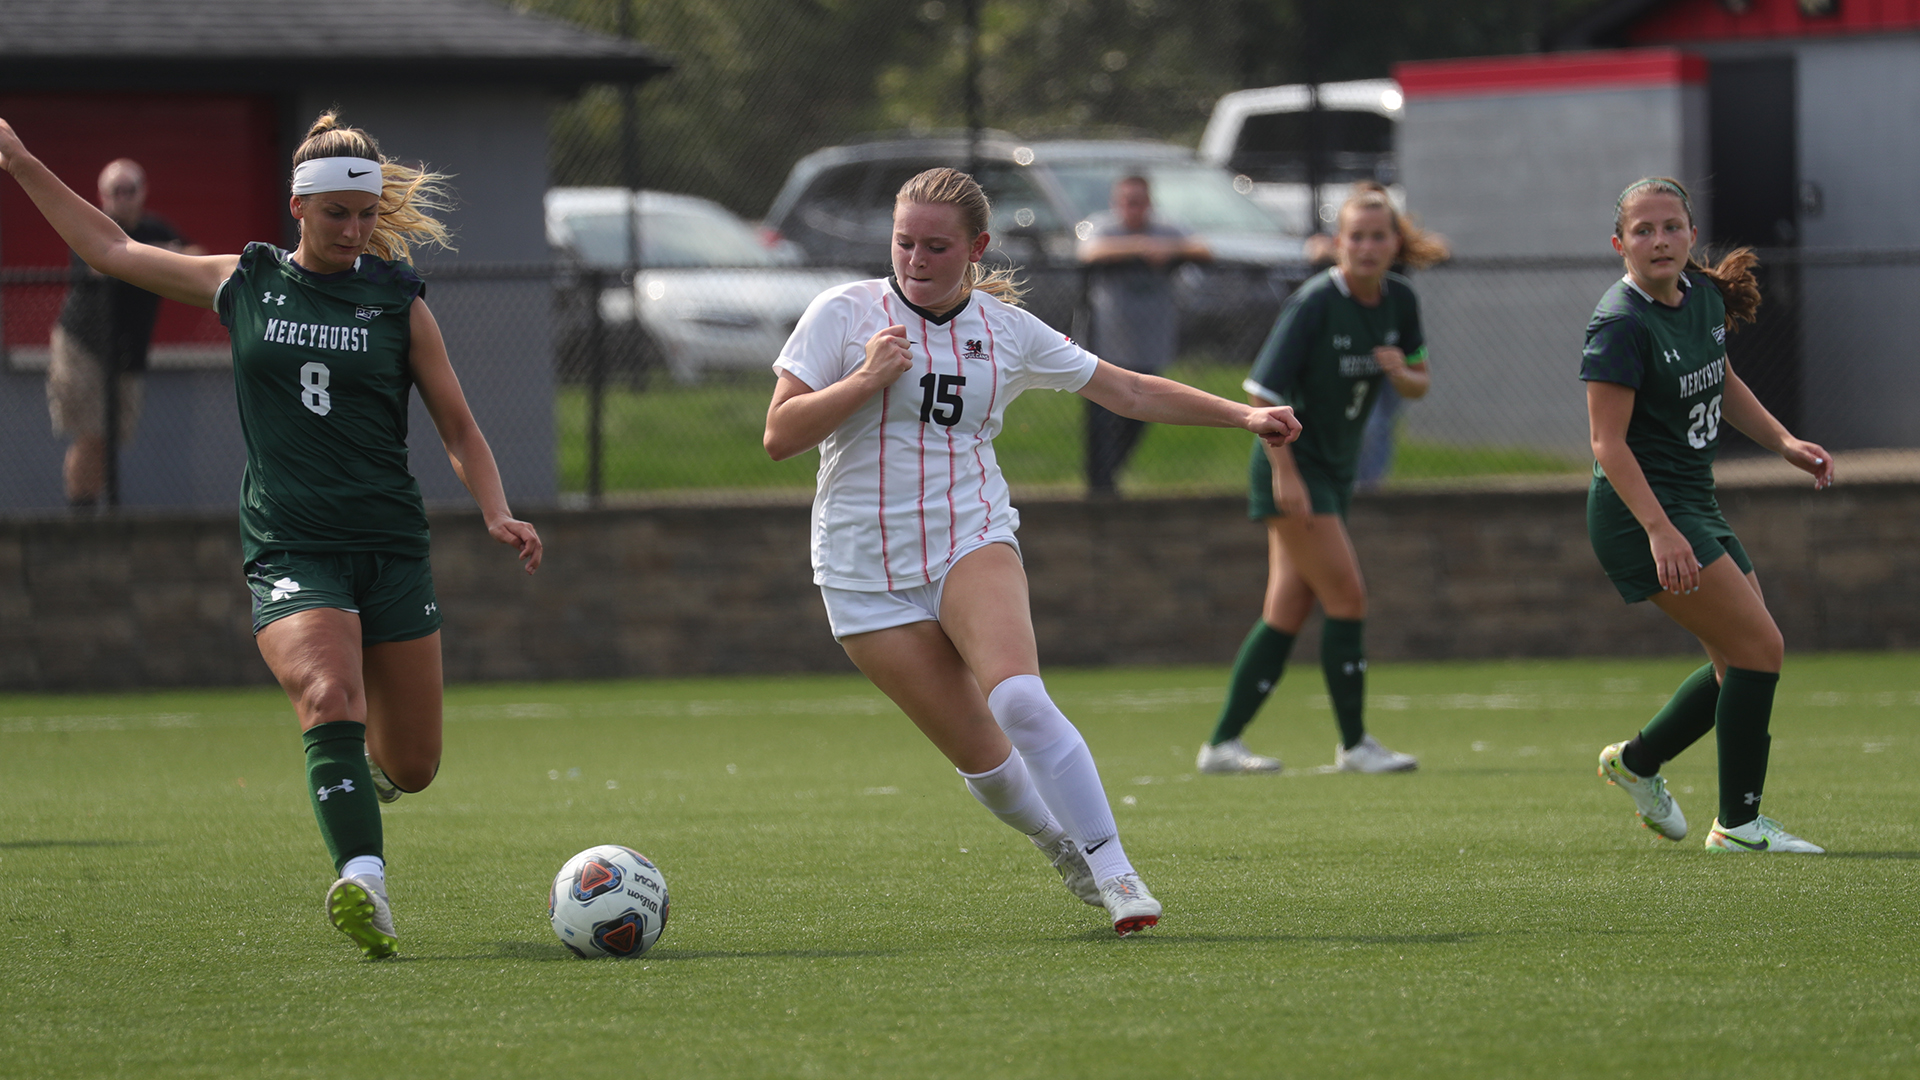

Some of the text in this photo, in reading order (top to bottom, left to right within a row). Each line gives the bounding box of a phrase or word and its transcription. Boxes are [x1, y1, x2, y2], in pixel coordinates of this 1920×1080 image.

[263, 318, 369, 352] MERCYHURST
[963, 352, 990, 361] VULCANS
[300, 361, 332, 416] 8
[919, 373, 967, 427] 15
[1344, 380, 1370, 420] 3
[1687, 394, 1722, 449] 20
[626, 888, 658, 914] Wilson
[634, 872, 660, 894] NCAA
